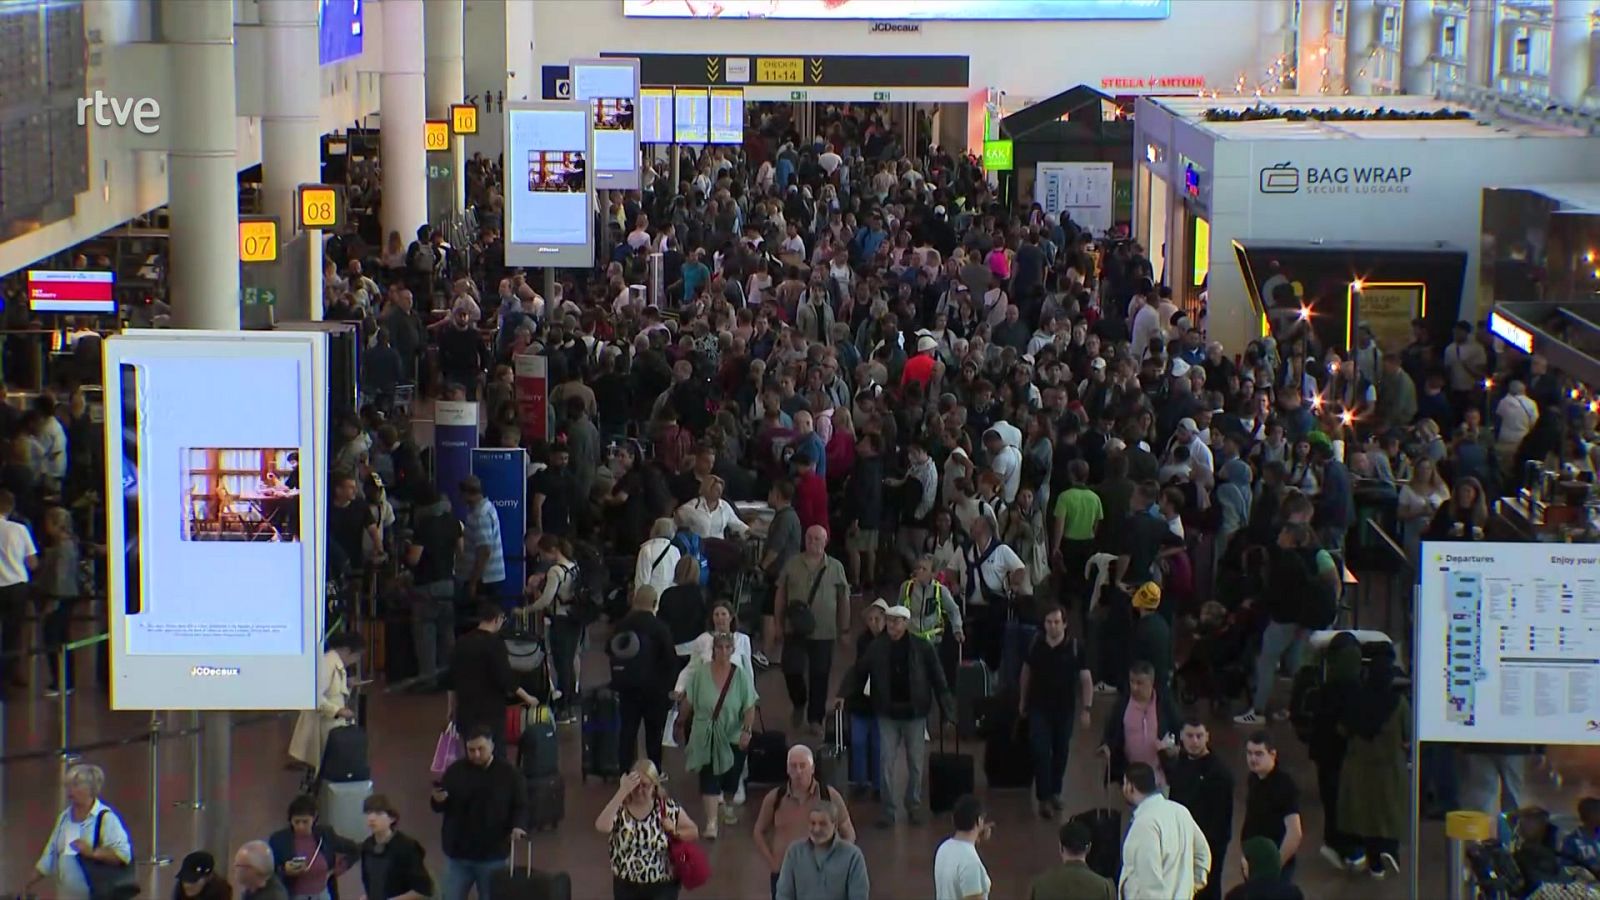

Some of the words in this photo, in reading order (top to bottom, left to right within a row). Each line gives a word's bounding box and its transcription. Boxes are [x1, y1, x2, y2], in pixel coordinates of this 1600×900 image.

[872, 23, 919, 32] JCDecaux
[765, 70, 796, 81] 11-14
[458, 116, 473, 129] 10
[427, 132, 445, 147] 09
[1307, 167, 1348, 184] BAG
[1353, 167, 1412, 184] WRAP
[1306, 186, 1349, 194] SECURE
[1355, 186, 1410, 194] LUGGAGE
[307, 202, 331, 221] 08
[245, 236, 271, 256] 07
[1446, 555, 1495, 563] Departures
[1551, 556, 1574, 565] Enjoy
[191, 666, 237, 676] JCDecaux
